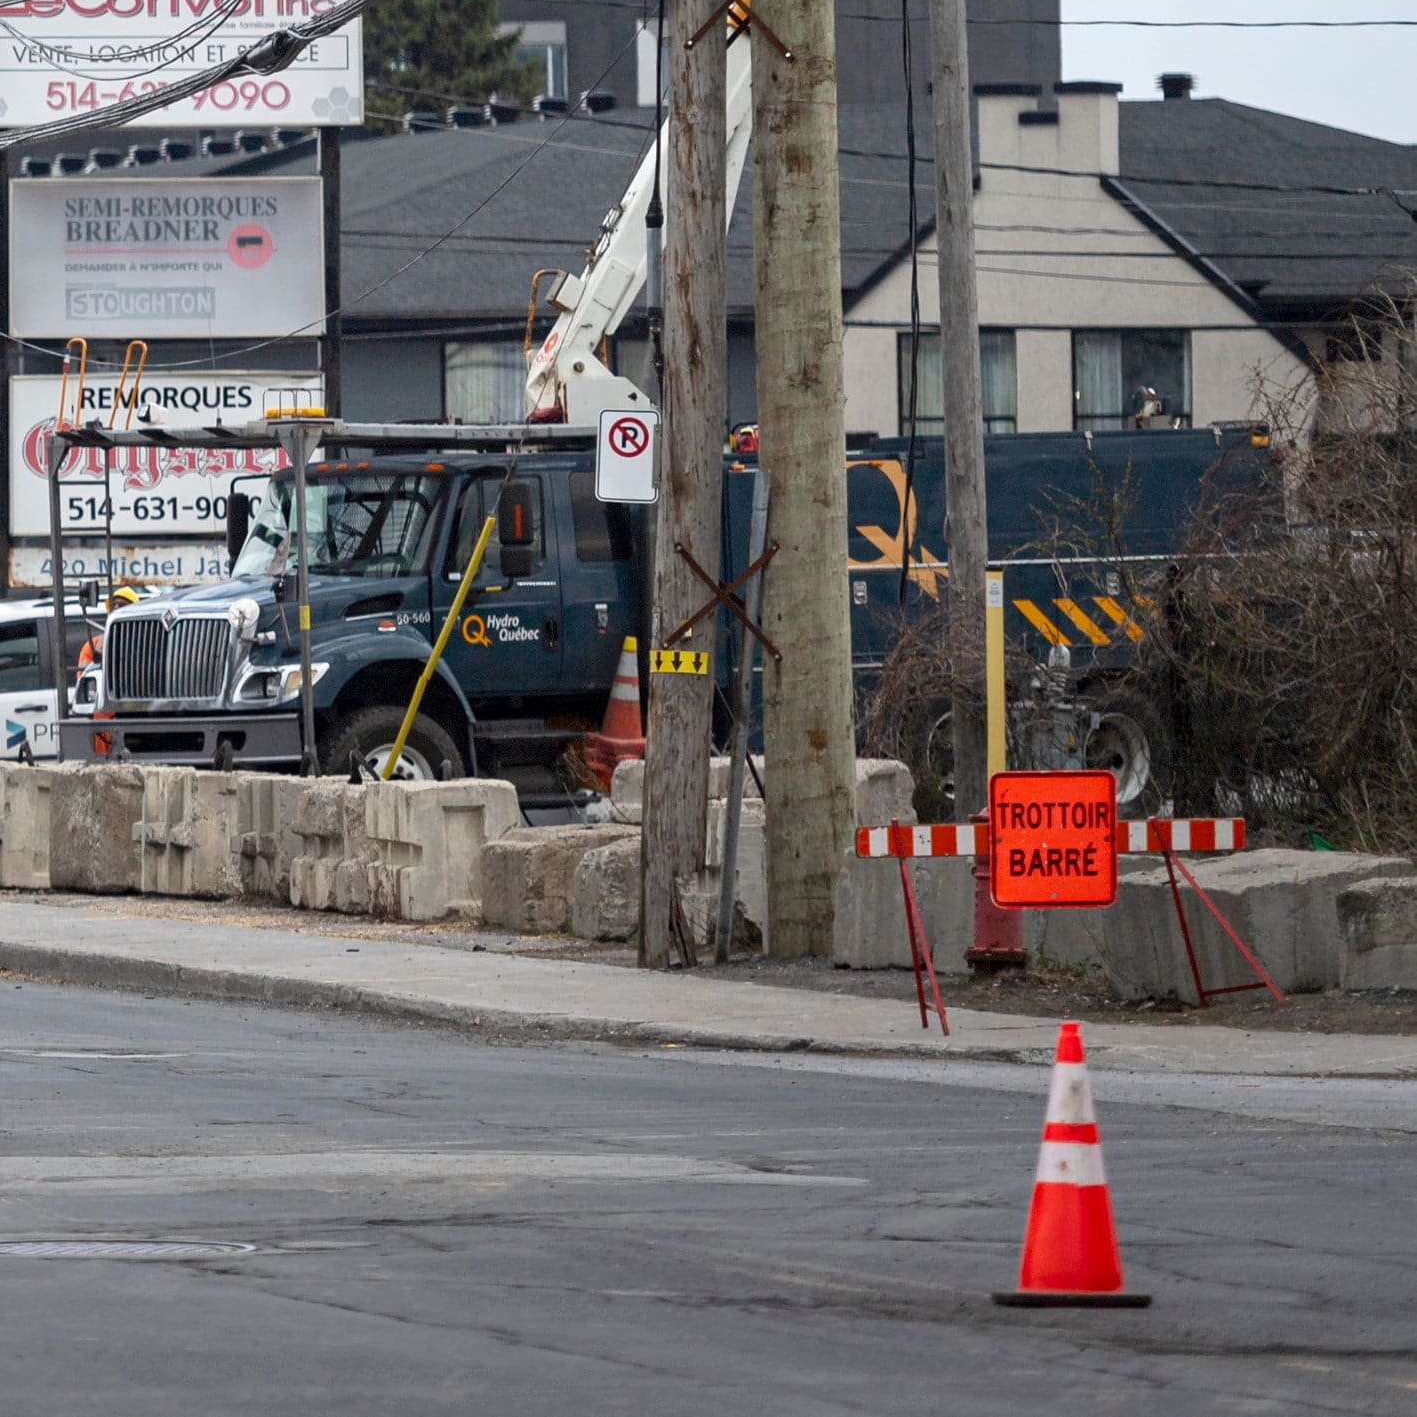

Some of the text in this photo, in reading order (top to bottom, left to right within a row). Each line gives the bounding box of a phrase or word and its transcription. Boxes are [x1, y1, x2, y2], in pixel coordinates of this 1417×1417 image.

[13, 45, 78, 65] VENTE,
[89, 45, 195, 63] LOCATION
[207, 45, 226, 62] ET
[65, 196, 278, 219] SEMI-REMORQUES
[66, 220, 221, 244] BREADNER
[65, 263, 126, 273] DEMANDER
[140, 263, 199, 272] N'IMPORTE
[202, 263, 223, 272] QUI
[72, 291, 212, 315] STOUGHTON
[81, 386, 252, 412] REMORQUES
[68, 496, 262, 521] 514-631-900
[98, 556, 182, 576] Michel
[486, 613, 519, 628] Hydro
[499, 627, 540, 642] Québec
[997, 802, 1109, 829] TROTTOIR
[1010, 842, 1099, 877] BARRÉ
